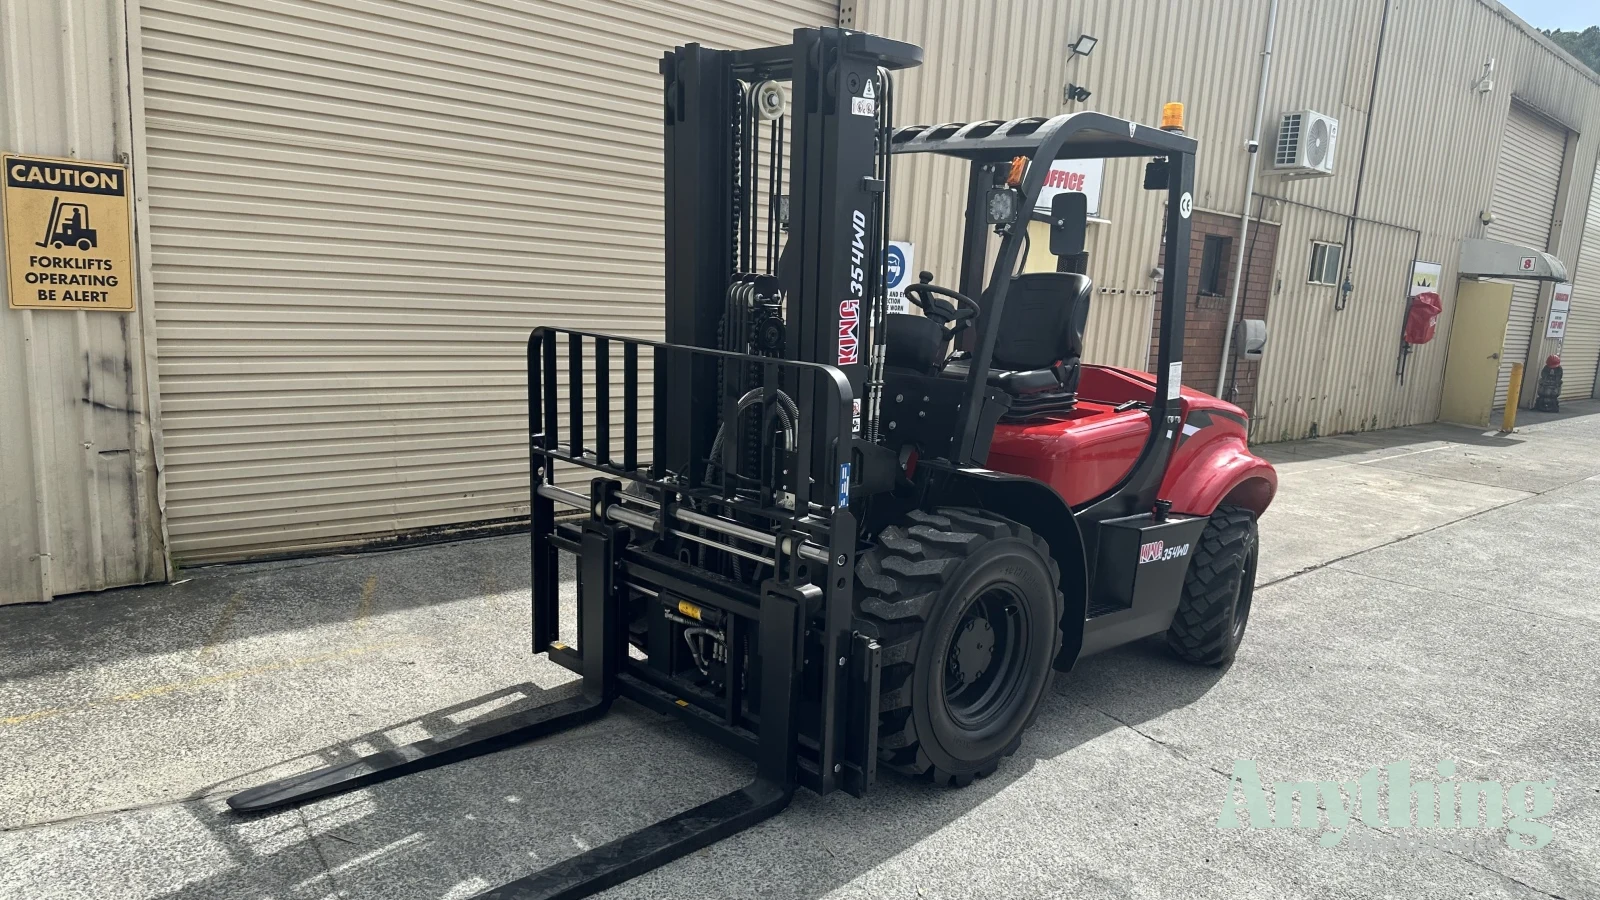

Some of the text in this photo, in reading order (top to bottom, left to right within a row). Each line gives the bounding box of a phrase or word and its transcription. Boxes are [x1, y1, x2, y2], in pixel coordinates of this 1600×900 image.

[11, 164, 118, 190] CAUTION
[1181, 199, 1191, 212] CE
[29, 255, 113, 271] FORKLIFTS
[1524, 259, 1531, 269] 8
[25, 272, 118, 287] OPERATING
[838, 209, 866, 366] KING 354WD
[38, 289, 108, 302] BE ALERT
[1139, 540, 1190, 564] KING 354WD
